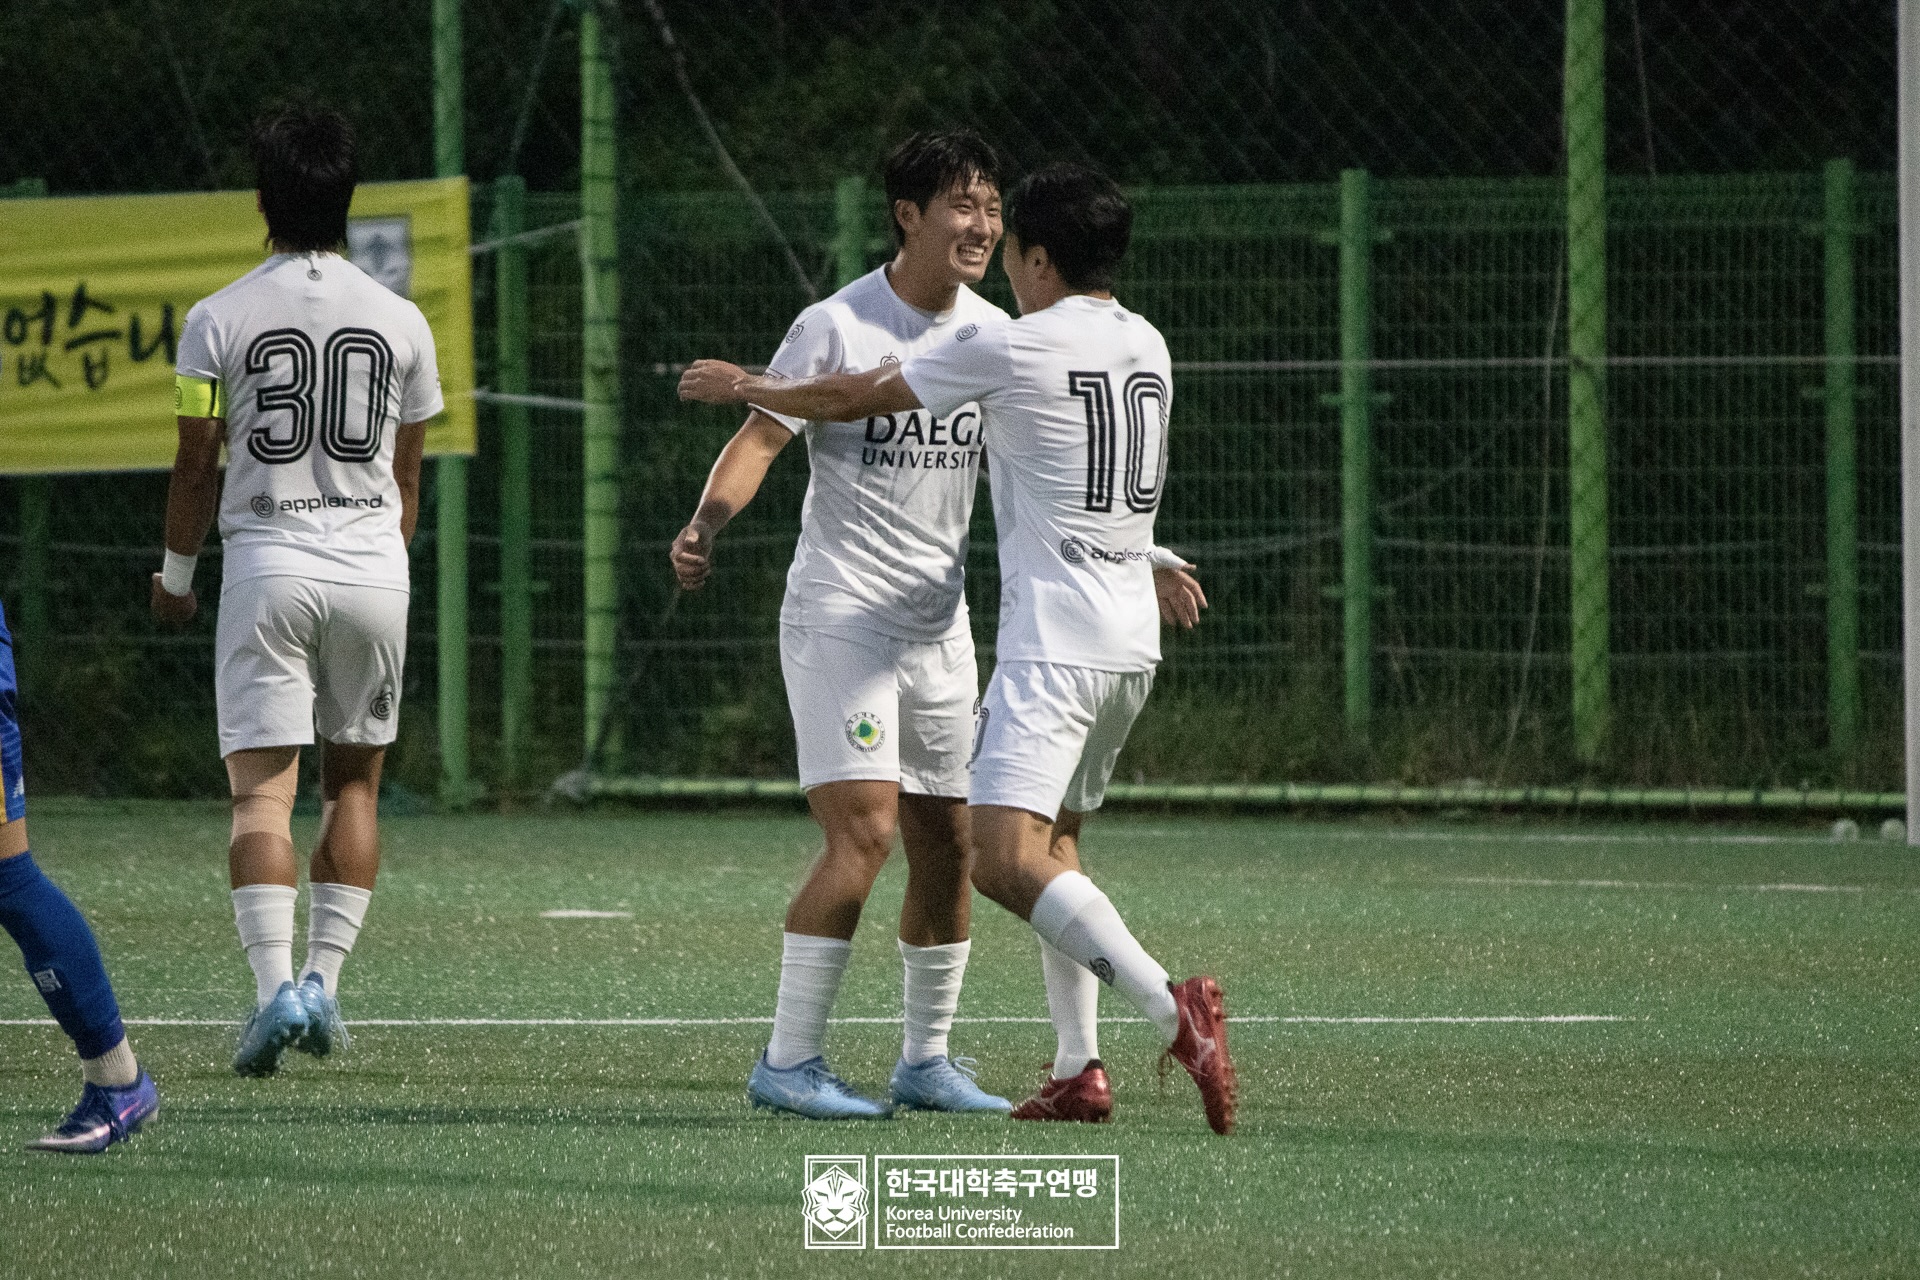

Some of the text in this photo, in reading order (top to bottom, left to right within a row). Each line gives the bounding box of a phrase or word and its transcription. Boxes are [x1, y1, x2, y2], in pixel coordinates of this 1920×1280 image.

[4, 282, 177, 392] 없습니
[245, 326, 394, 465] 30
[864, 411, 984, 447] DAEG
[1068, 370, 1168, 514] 10
[862, 447, 979, 470] UNIVERSIT
